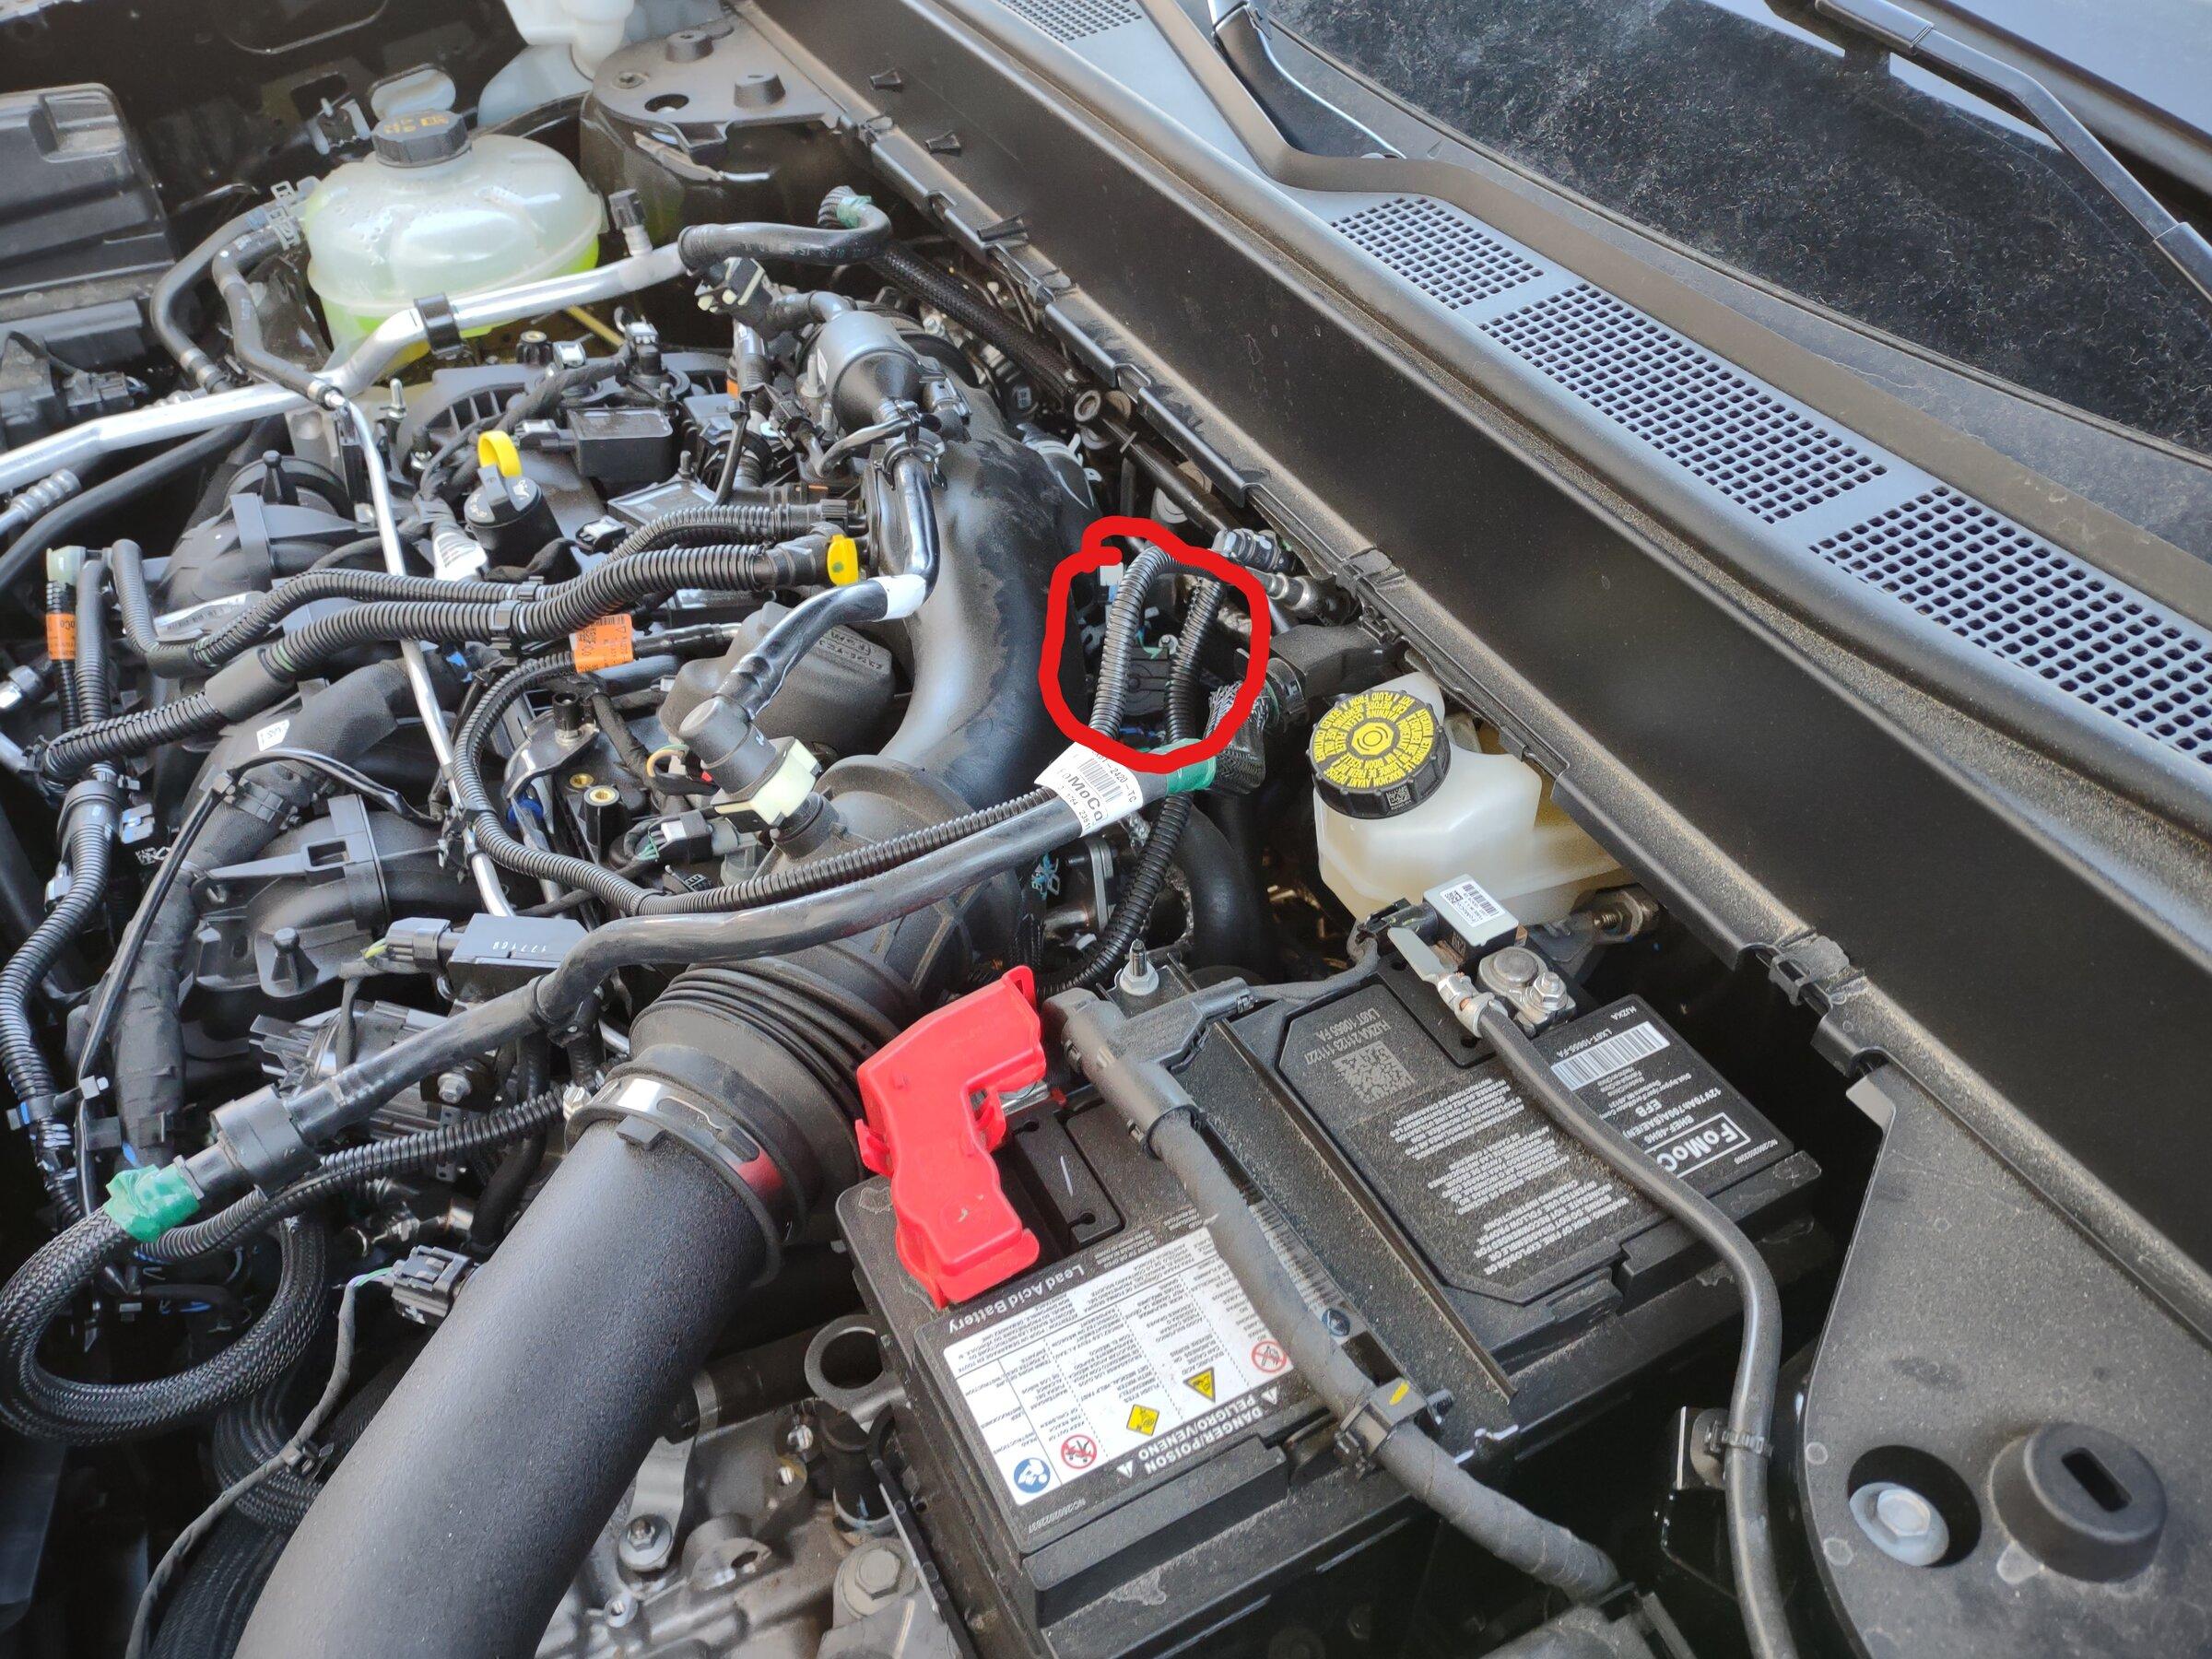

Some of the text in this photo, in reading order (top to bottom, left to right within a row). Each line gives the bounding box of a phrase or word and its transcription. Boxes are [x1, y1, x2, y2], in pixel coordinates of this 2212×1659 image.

[1347, 693, 1369, 707] FROM
[1364, 700, 1393, 711] BEFORE
[1371, 691, 1394, 700] FLUID
[1398, 694, 1416, 707] DOT
[1365, 709, 1401, 722] WARNING
[1633, 1098, 1663, 1117] EFB
[1653, 1122, 1738, 1173] FoMoC
[1044, 1263, 1085, 1290] Lead
[1006, 1281, 1046, 1308] Acid
[944, 1296, 1008, 1336] Battery
[1135, 1392, 1257, 1462] PELIGRO/VENENO
[1142, 1406, 1264, 1474] DANGER/POISON
